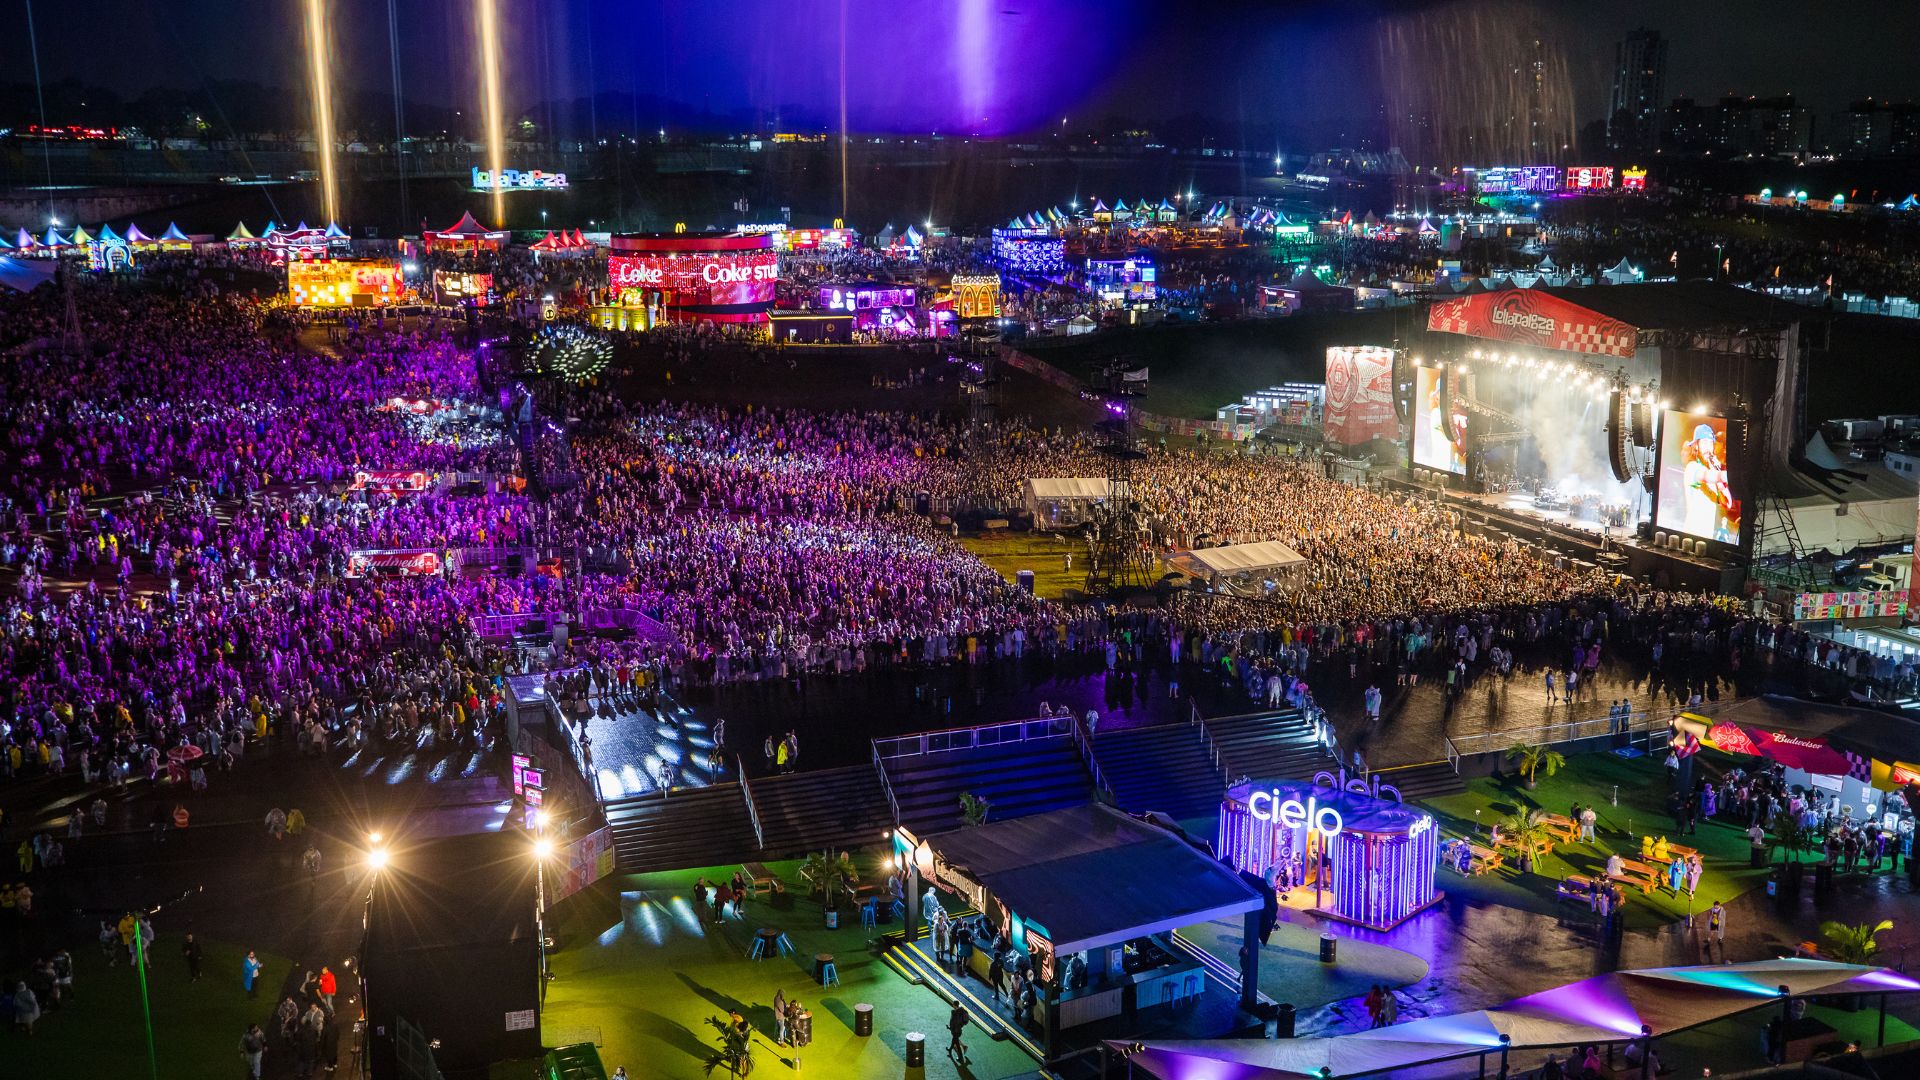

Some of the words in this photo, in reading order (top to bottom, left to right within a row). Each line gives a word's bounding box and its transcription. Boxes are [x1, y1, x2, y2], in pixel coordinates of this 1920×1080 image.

[472, 166, 569, 187] Lolapalooza
[737, 223, 787, 232] McDonald's
[618, 263, 663, 282] Coke
[703, 258, 752, 283] Coke
[1492, 306, 1555, 330] Lollapalooza
[361, 556, 424, 568] Budweise
[1772, 733, 1822, 749] Budweiser
[1249, 789, 1343, 837] cielo
[1409, 815, 1432, 838] cielo
